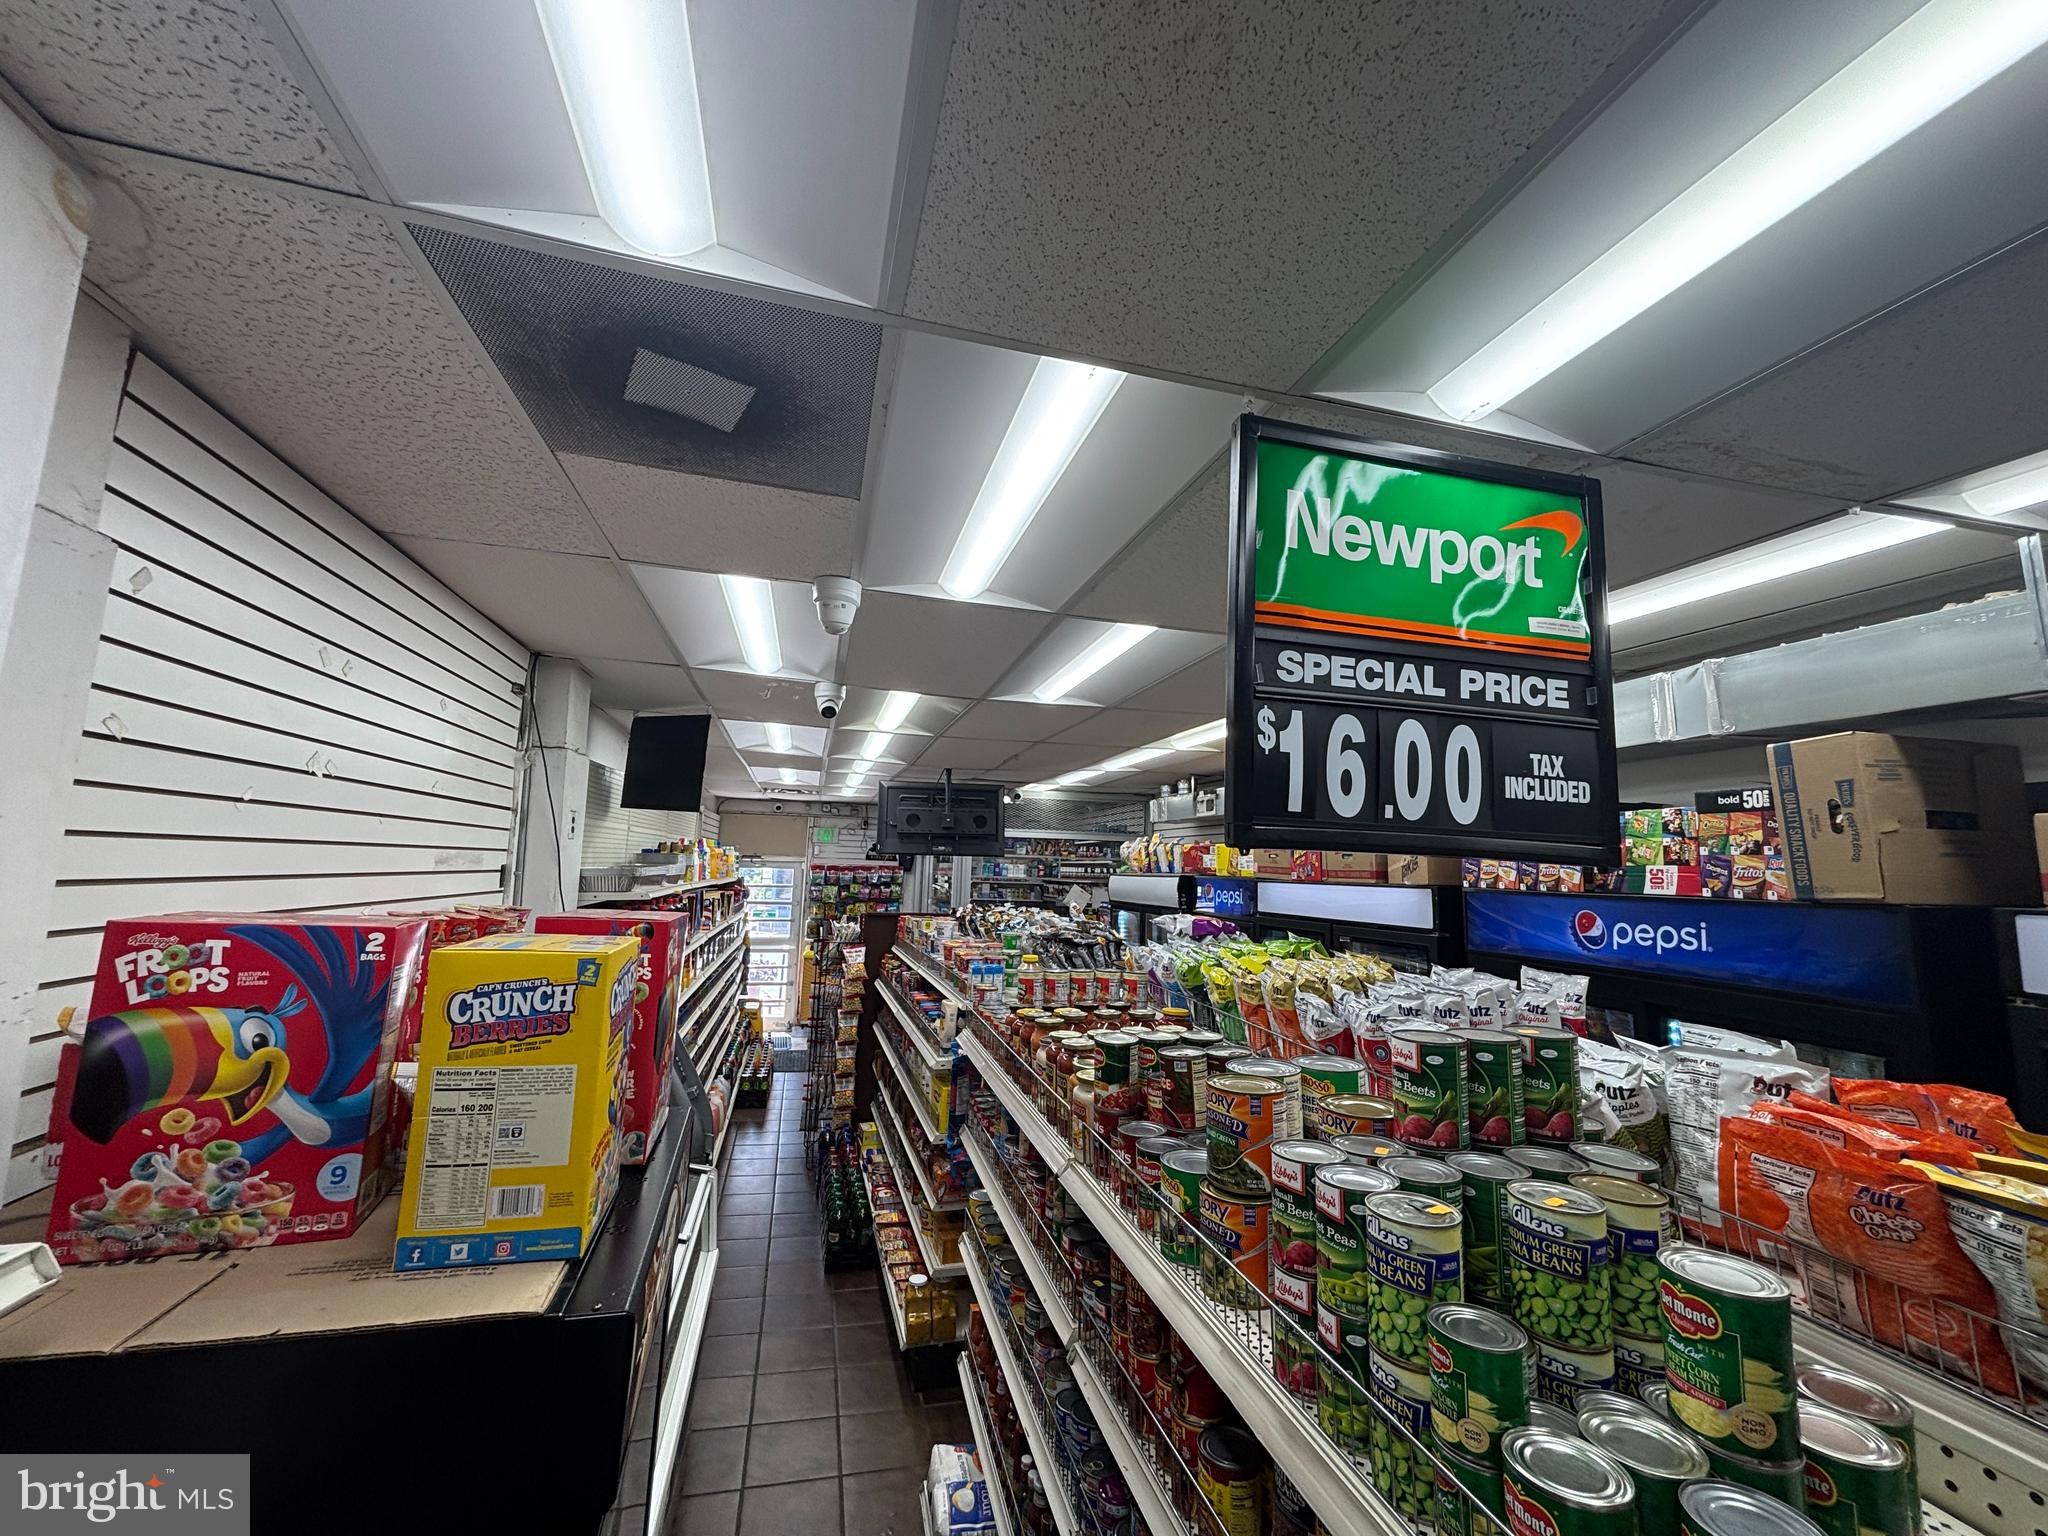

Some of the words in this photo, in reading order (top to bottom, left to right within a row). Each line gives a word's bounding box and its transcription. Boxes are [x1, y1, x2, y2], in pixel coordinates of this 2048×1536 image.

[1286, 489, 1543, 589] Newport
[1276, 650, 1446, 697] SPECIAL
[1460, 669, 1570, 709] PRICE
[1257, 705, 1482, 825] $16.00
[1530, 753, 1564, 778] TAX
[1504, 775, 1591, 805] INCLUDED
[1717, 795, 1740, 805] bold
[1742, 790, 1763, 809] 50
[1784, 792, 1800, 825] QUALITY
[1789, 828, 1805, 859] SNACK
[1649, 868, 1665, 884] 50
[1793, 858, 1810, 887] FOODS
[1215, 887, 1244, 907] pepsi
[128, 933, 179, 946] Kellogg's
[365, 932, 386, 952] 2
[1612, 921, 1708, 955] pepsi
[115, 940, 231, 982] FROOT
[360, 953, 386, 962] BAGS
[584, 965, 596, 977] 2
[125, 967, 230, 1005] LOOPS
[477, 983, 504, 993] CAP'N
[504, 978, 549, 991] CRUNCH'S
[449, 984, 577, 1024] CRUNCH
[1519, 1013, 1550, 1024] Original
[452, 1012, 571, 1050] BERRIES
[1403, 1082, 1436, 1098] Beets
[460, 1104, 475, 1112] 160
[477, 1103, 494, 1112] 200
[1608, 1101, 1640, 1113] ipples
[1217, 1133, 1236, 1146] GREENS
[1785, 1121, 1817, 1134] Nutrition
[1818, 1130, 1841, 1141] Facts
[330, 1165, 347, 1185] 9
[1273, 1161, 1299, 1182] Libby's
[1753, 1156, 1787, 1171] Nutrition
[1788, 1167, 1812, 1178] Facts
[1274, 1188, 1294, 1203] Small
[1849, 1206, 1925, 1233] Cheese
[1998, 1221, 2023, 1236] acts
[1326, 1228, 1358, 1249] Peas
[1865, 1224, 1918, 1243] Curls
[1542, 1241, 1583, 1261] GREEN
[1388, 1253, 1427, 1275] GREEN
[1532, 1249, 1583, 1276] BEANS
[1379, 1265, 1427, 1291] BEANS
[1276, 1278, 1304, 1301] Libby's
[1673, 1301, 1716, 1330] Monte
[1667, 1333, 1686, 1353] Fresh
[1684, 1346, 1706, 1361] Cut
[1687, 1361, 1720, 1386] CORN
[1688, 1373, 1721, 1397] STYLE
[1379, 1390, 1413, 1420] GREEN
[1690, 1389, 1720, 1407] ADDED
[1464, 1426, 1482, 1438] NON
[1741, 1418, 1766, 1430] NON
[1741, 1424, 1767, 1437] GMO
[1464, 1432, 1482, 1445] GMO
[1804, 1475, 1830, 1496] nte
[1515, 1501, 1555, 1536] Monte
